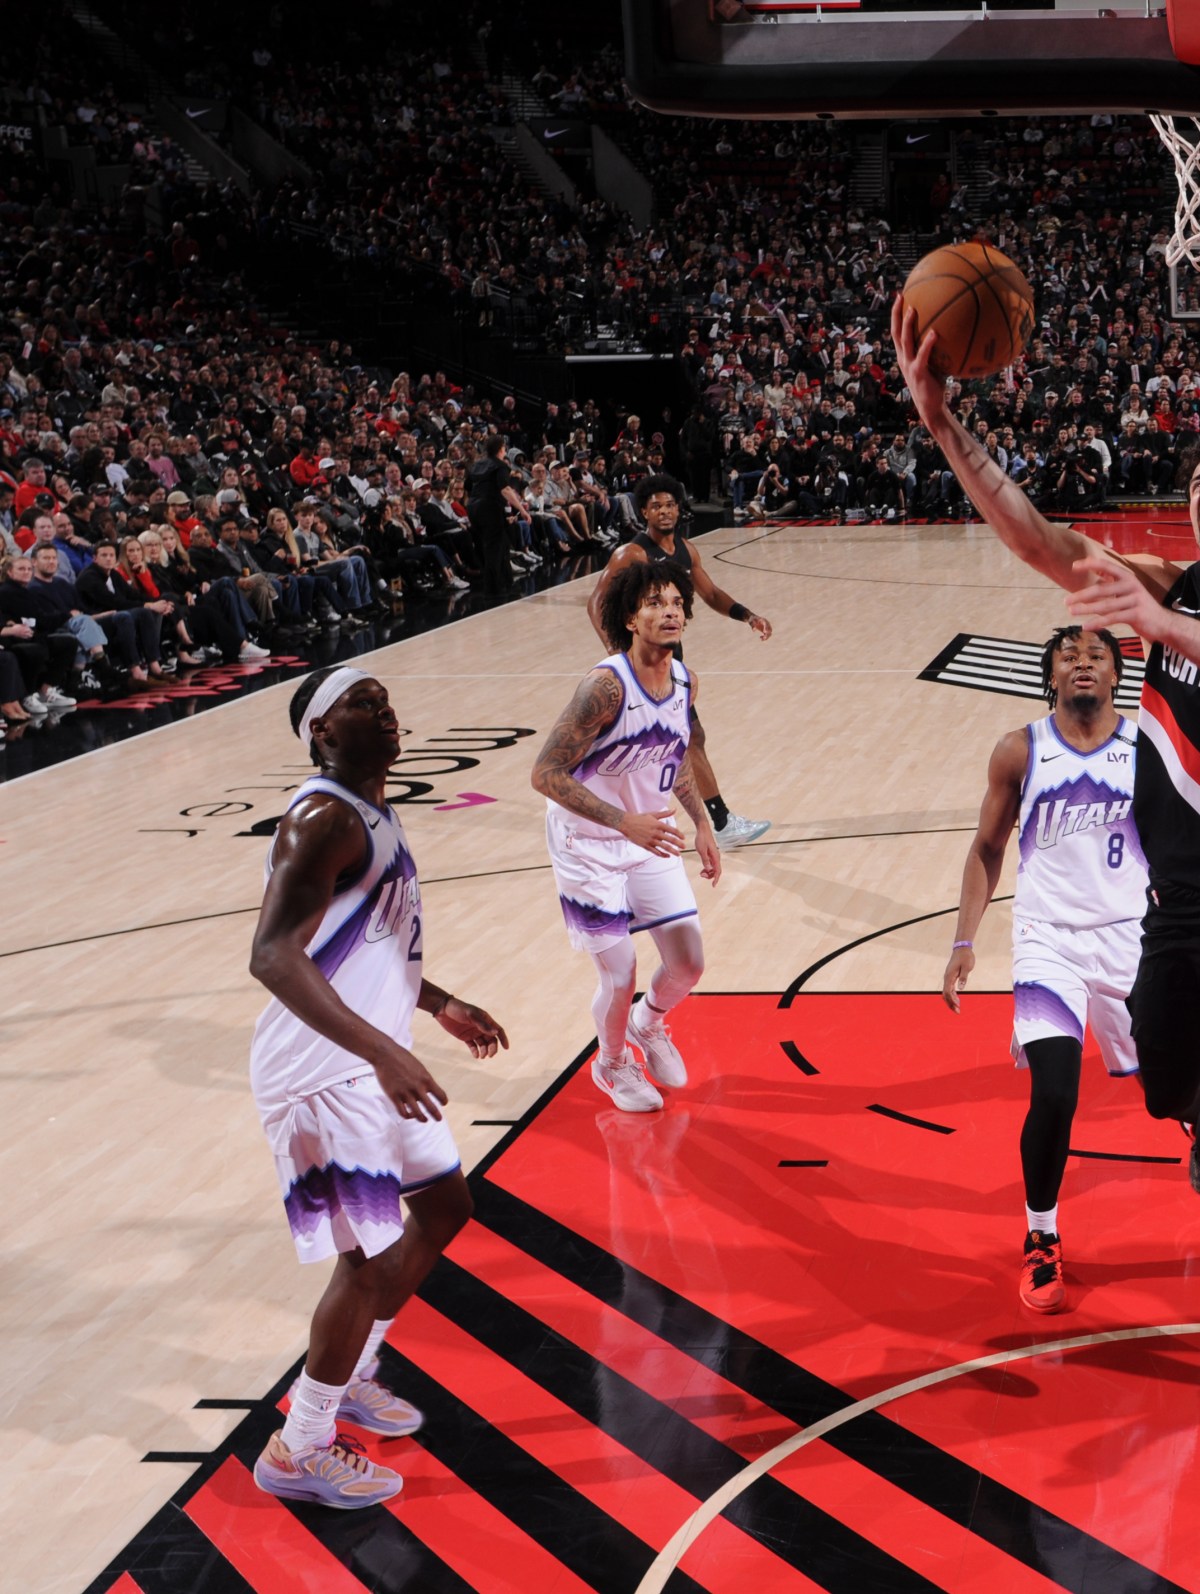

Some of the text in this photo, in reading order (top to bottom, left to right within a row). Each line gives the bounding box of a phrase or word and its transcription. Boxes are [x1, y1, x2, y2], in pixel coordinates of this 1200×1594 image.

[596, 737, 681, 777] UTAH
[1107, 751, 1129, 764] LVT
[659, 763, 676, 793] 0
[1034, 798, 1134, 851] UTAH
[1107, 833, 1125, 869] 8
[407, 914, 423, 962] 2
